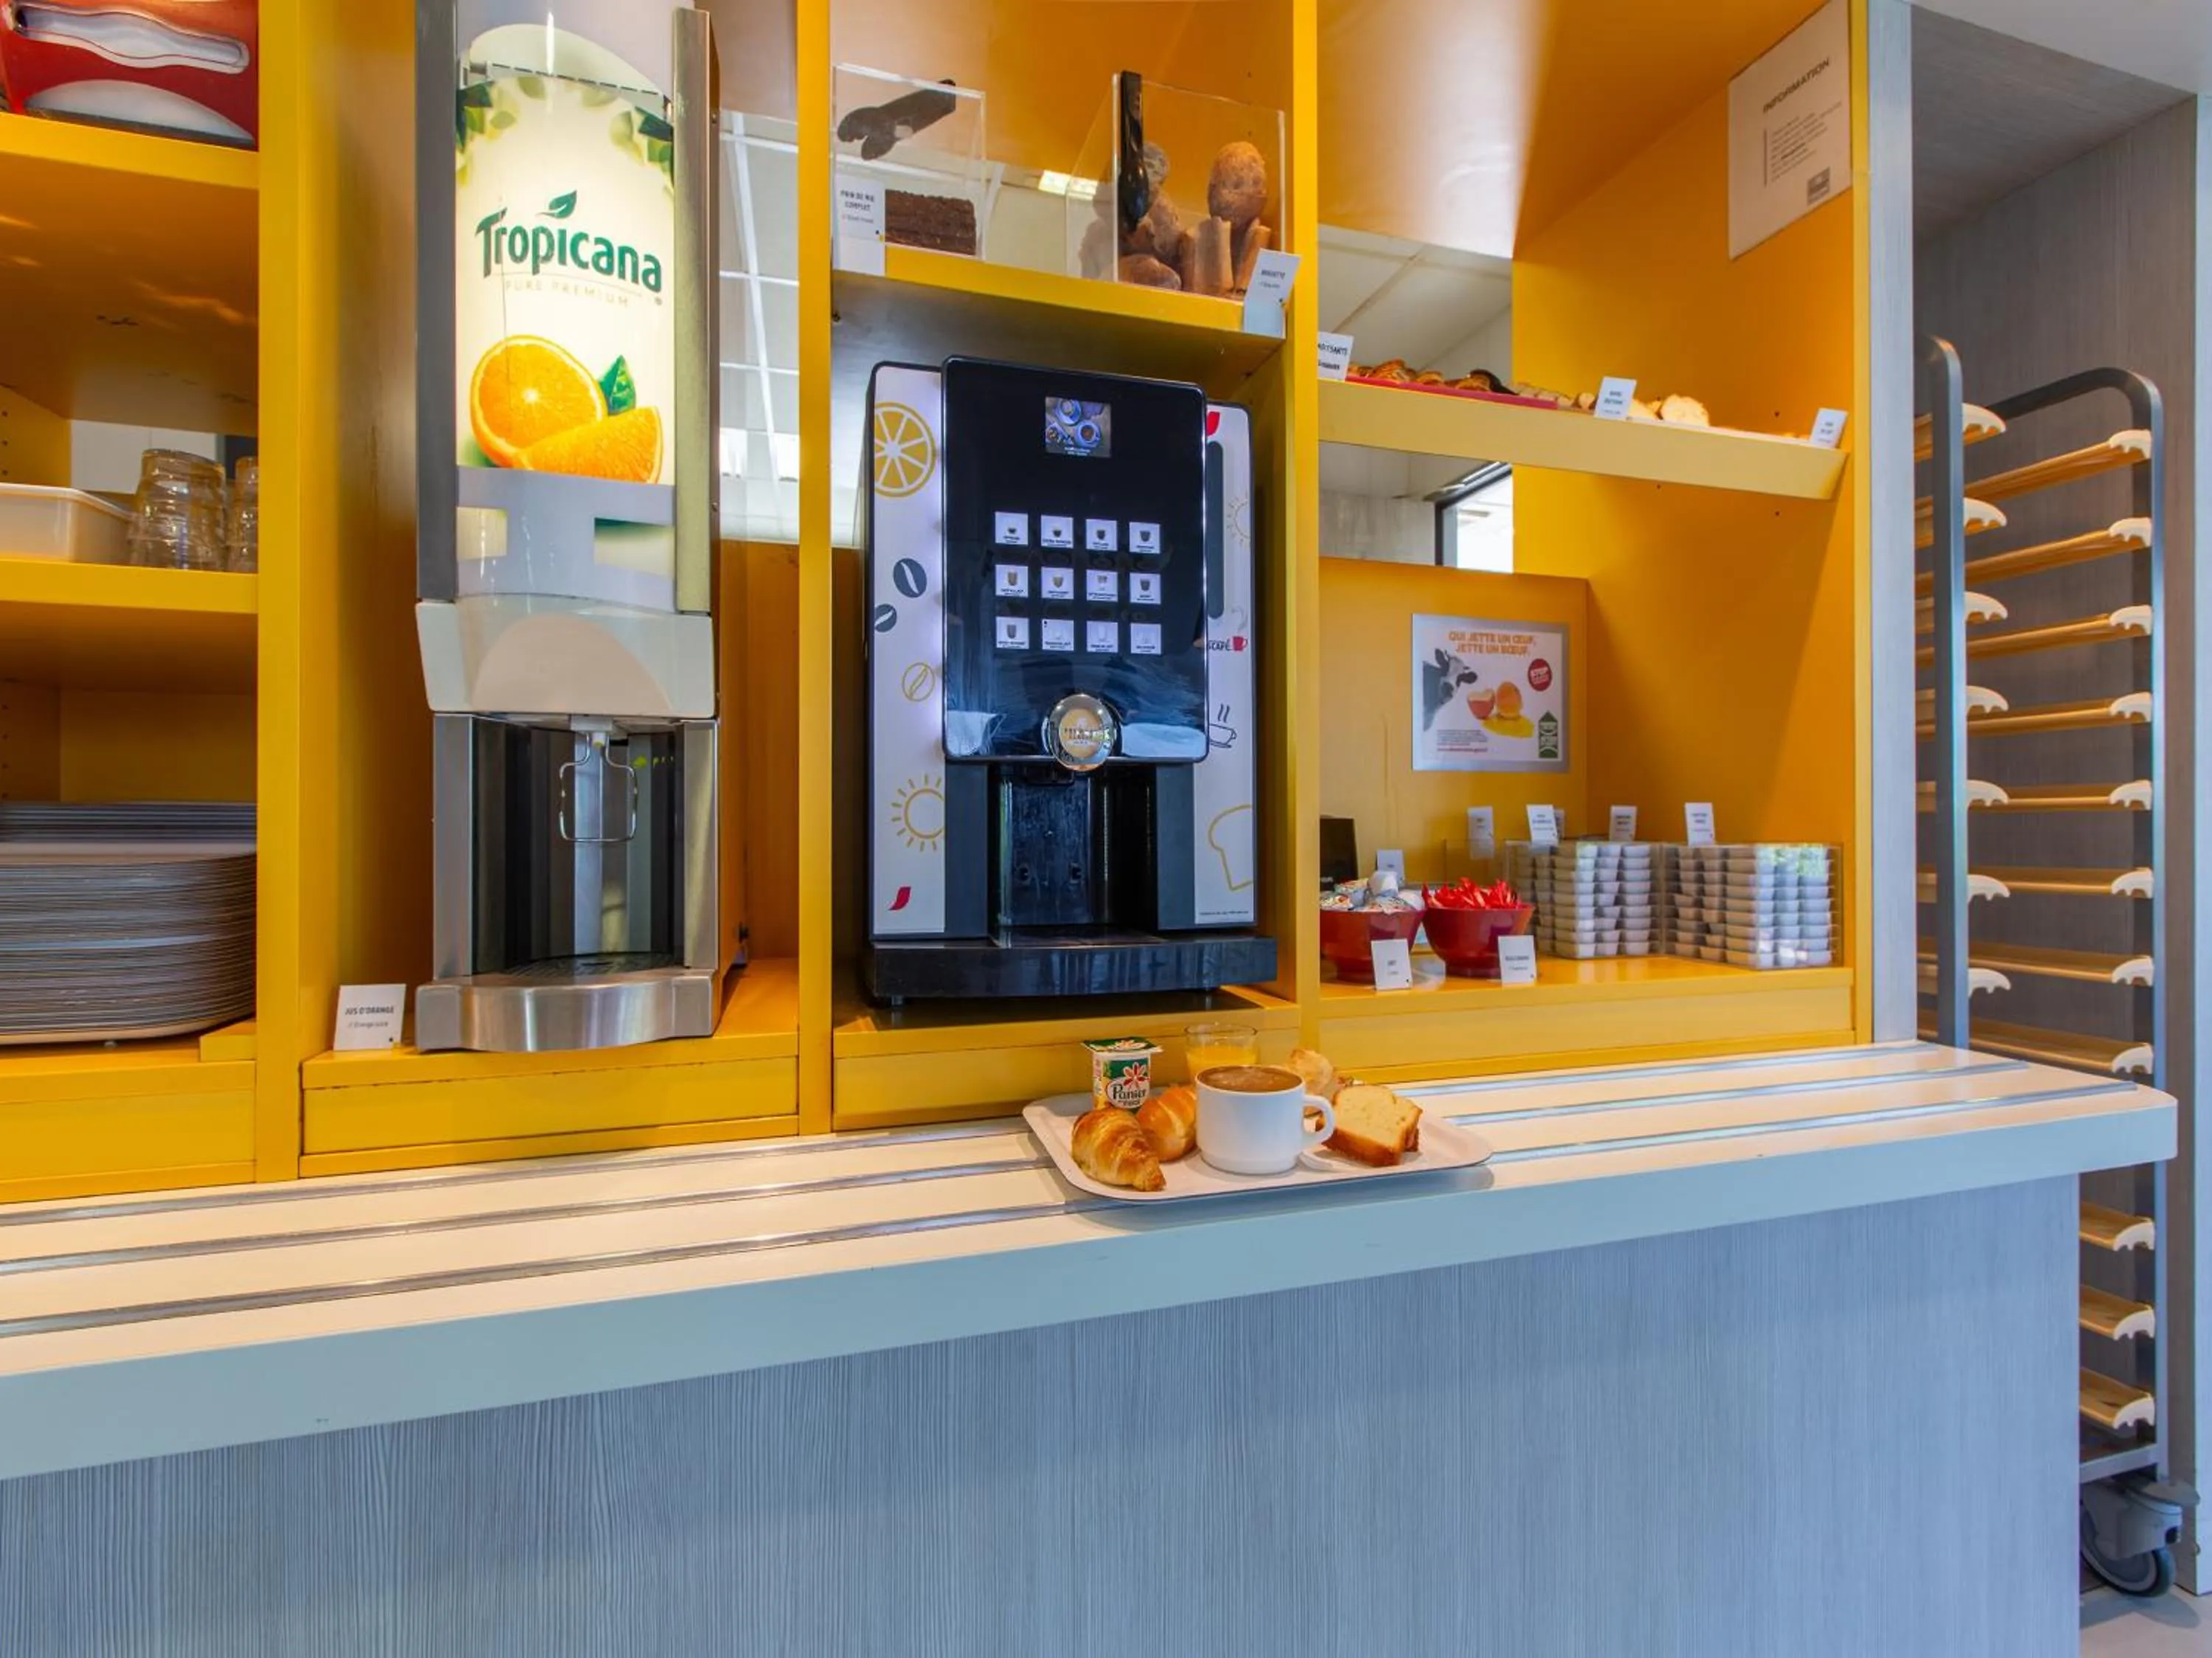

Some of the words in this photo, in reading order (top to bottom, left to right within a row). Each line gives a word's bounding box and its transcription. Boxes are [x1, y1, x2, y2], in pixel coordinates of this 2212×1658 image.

[1763, 57, 1830, 114] INFORMATION
[475, 207, 662, 294] Tropicana
[505, 279, 542, 291] PURE
[553, 281, 629, 308] PREMIUM
[1468, 632, 1495, 643] JETTE
[1456, 643, 1484, 653] JETTE
[345, 1006, 358, 1016] JUS
[359, 1005, 394, 1015] D'ORANGE
[1110, 1083, 1147, 1100] Panier
